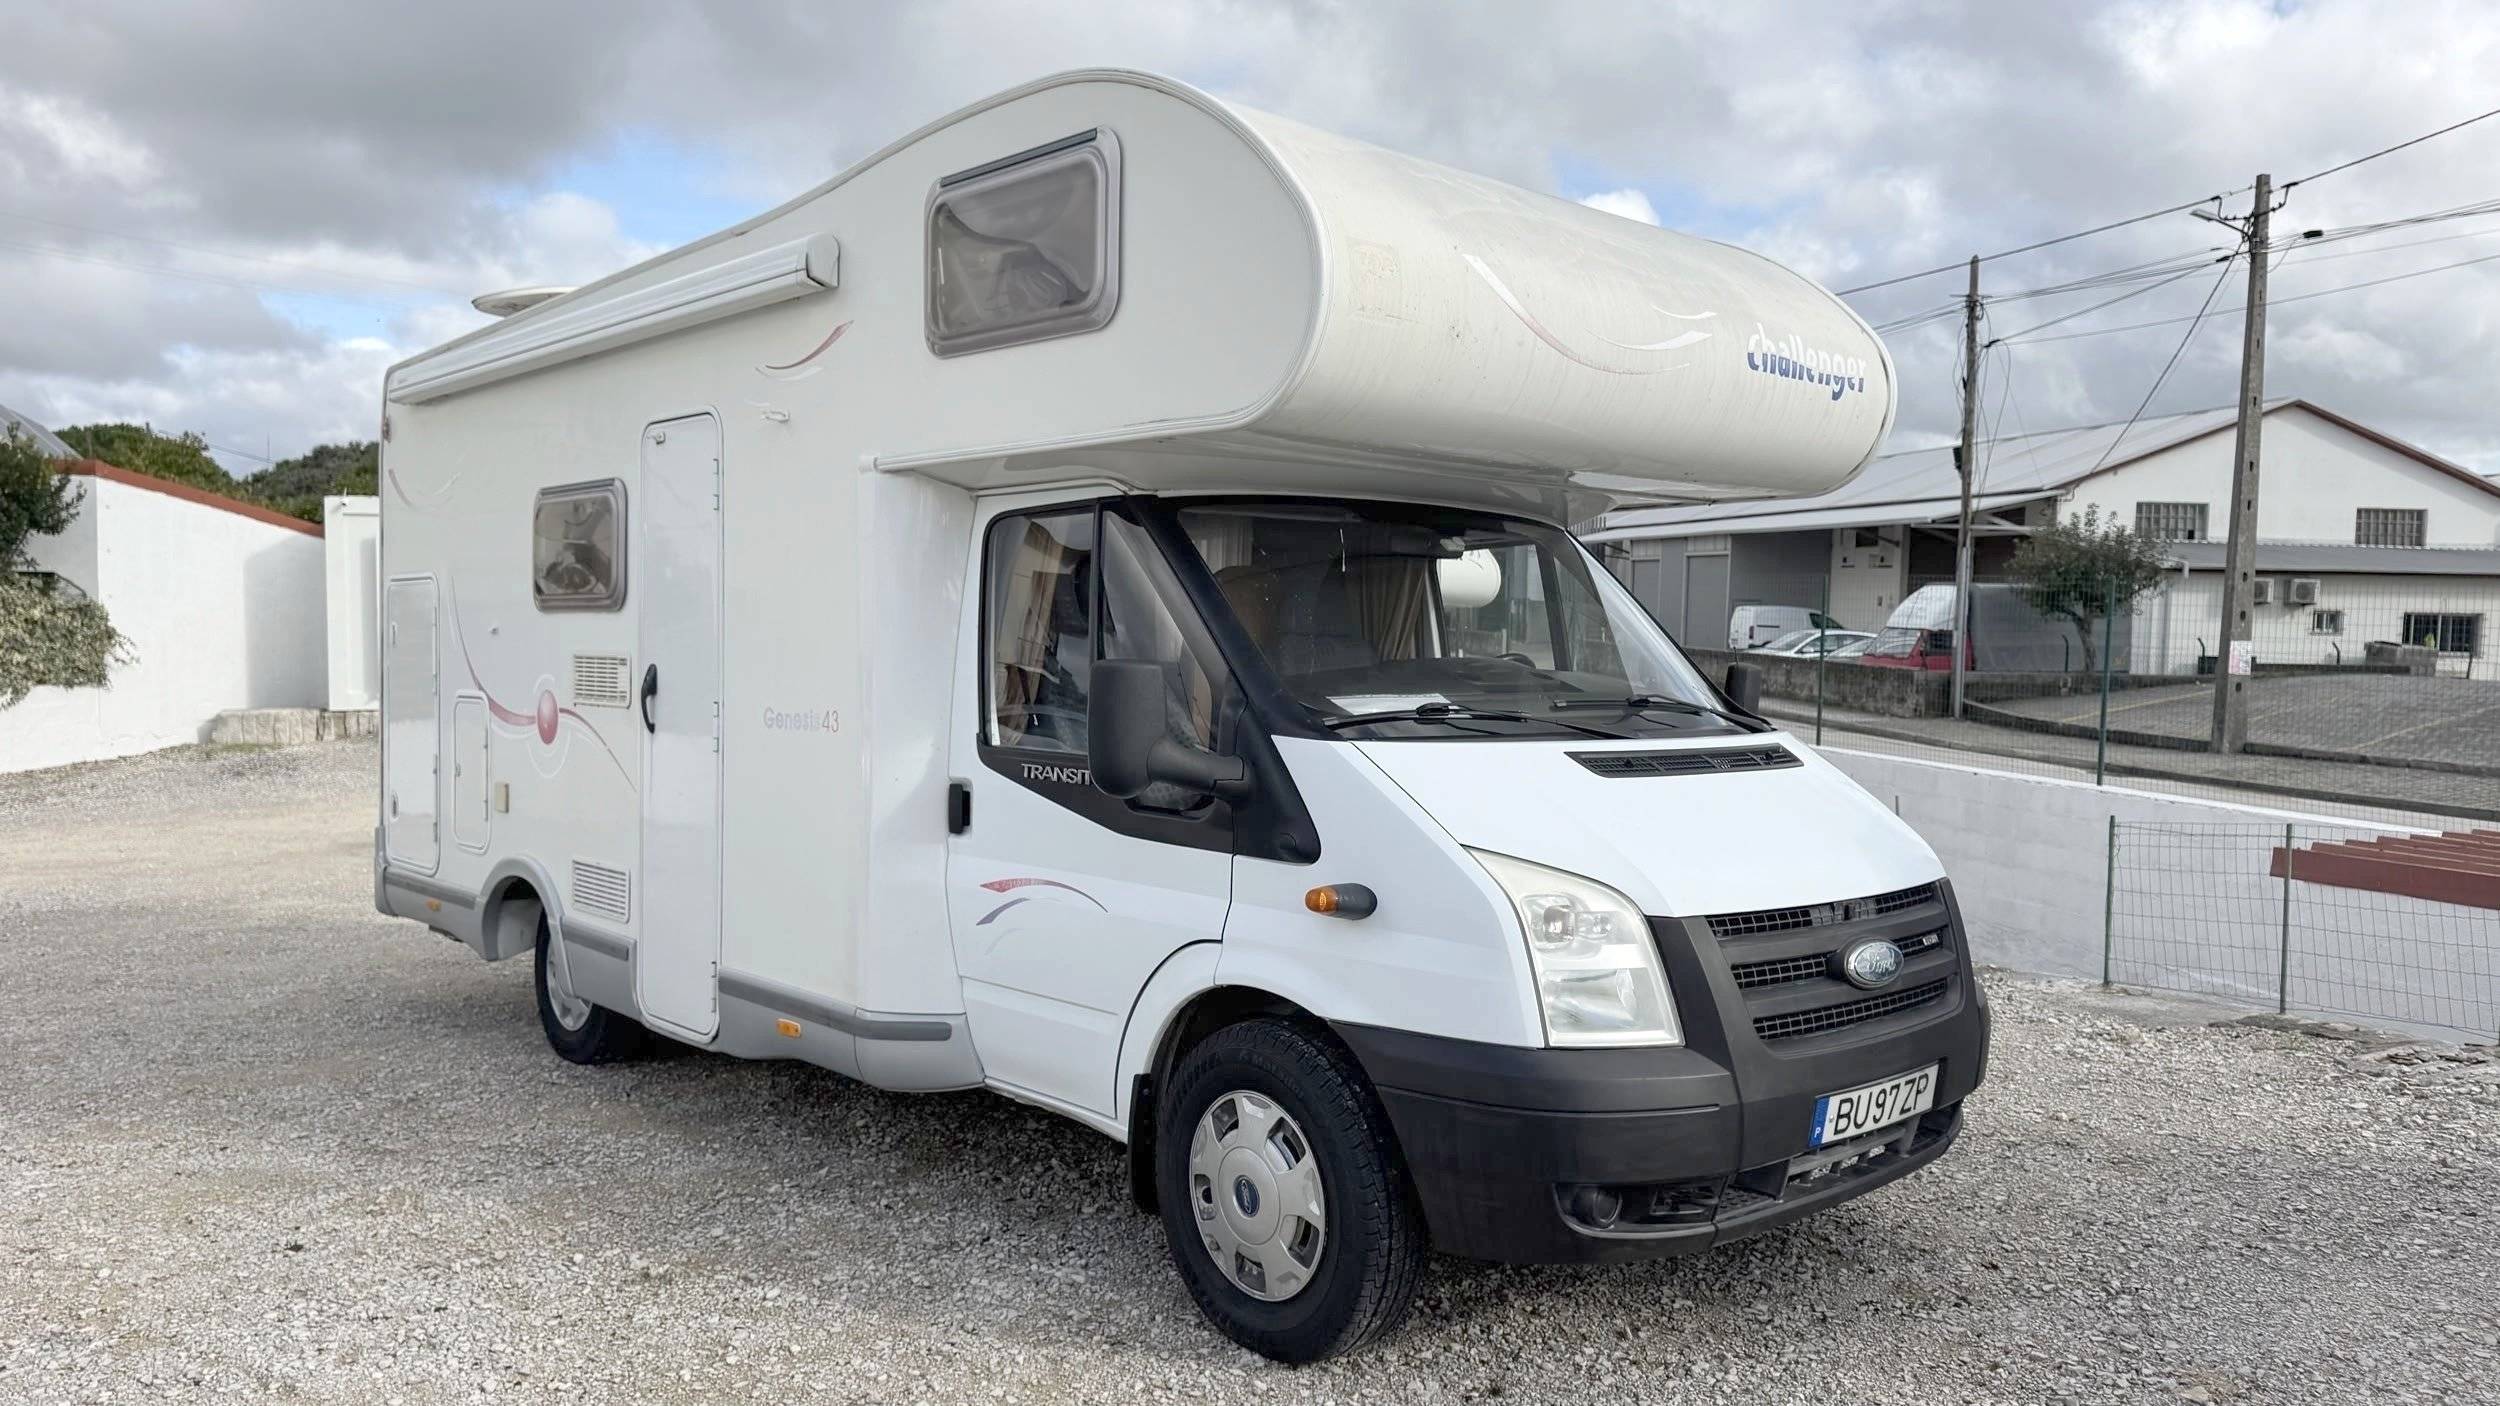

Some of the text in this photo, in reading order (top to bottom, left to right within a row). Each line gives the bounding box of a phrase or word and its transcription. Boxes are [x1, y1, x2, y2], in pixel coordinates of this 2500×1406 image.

[1747, 321, 1868, 400] challenger
[822, 709, 840, 732] 43
[1020, 762, 1091, 786] TRANSIT
[1833, 1072, 1929, 1136] BU97ZP
[1813, 1126, 1822, 1138] P
